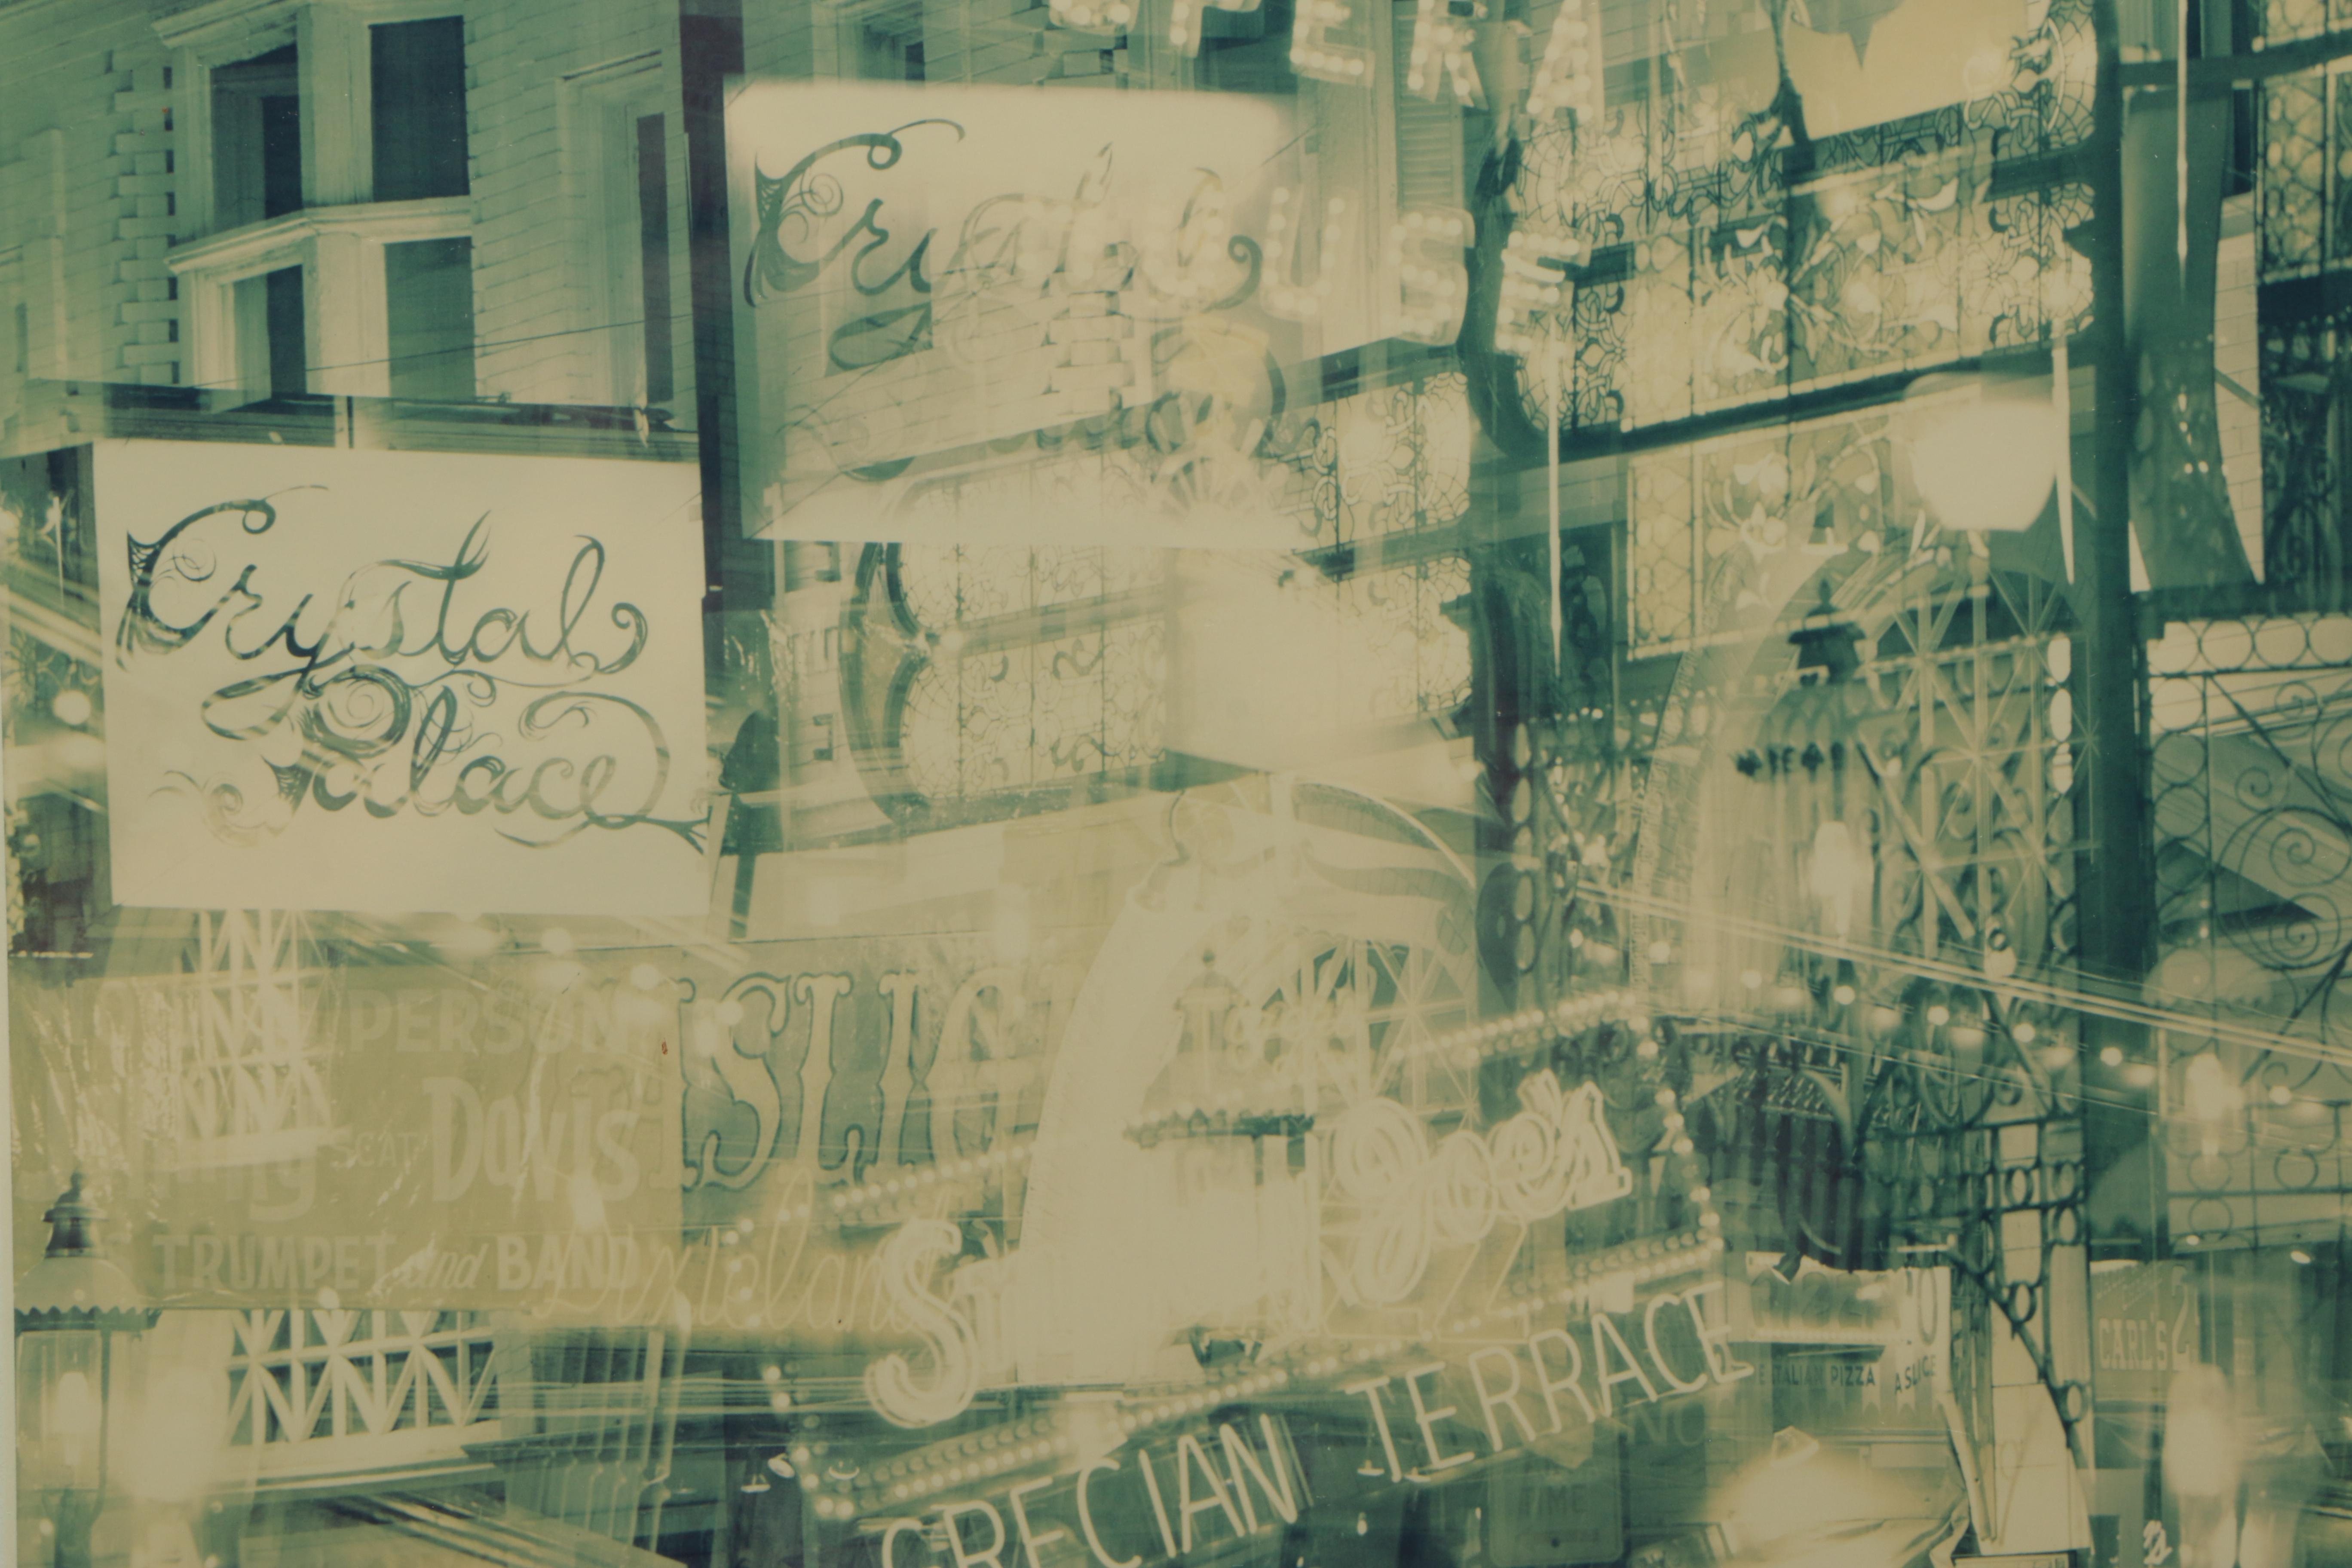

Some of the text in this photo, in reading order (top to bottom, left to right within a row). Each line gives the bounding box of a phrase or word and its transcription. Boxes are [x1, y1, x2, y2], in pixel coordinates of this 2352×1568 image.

[1048, 0, 1604, 122] ERA
[115, 484, 648, 741] Crystal
[146, 662, 711, 849] Palace
[152, 1235, 398, 1290] TRUMPET
[496, 1234, 640, 1290] BAND
[1344, 1282, 1755, 1484] TERRACE
[1830, 1365, 1876, 1387] PIZZA
[1894, 1355, 1937, 1395] A SLICE
[2099, 1311, 2168, 1371] CARL'S
